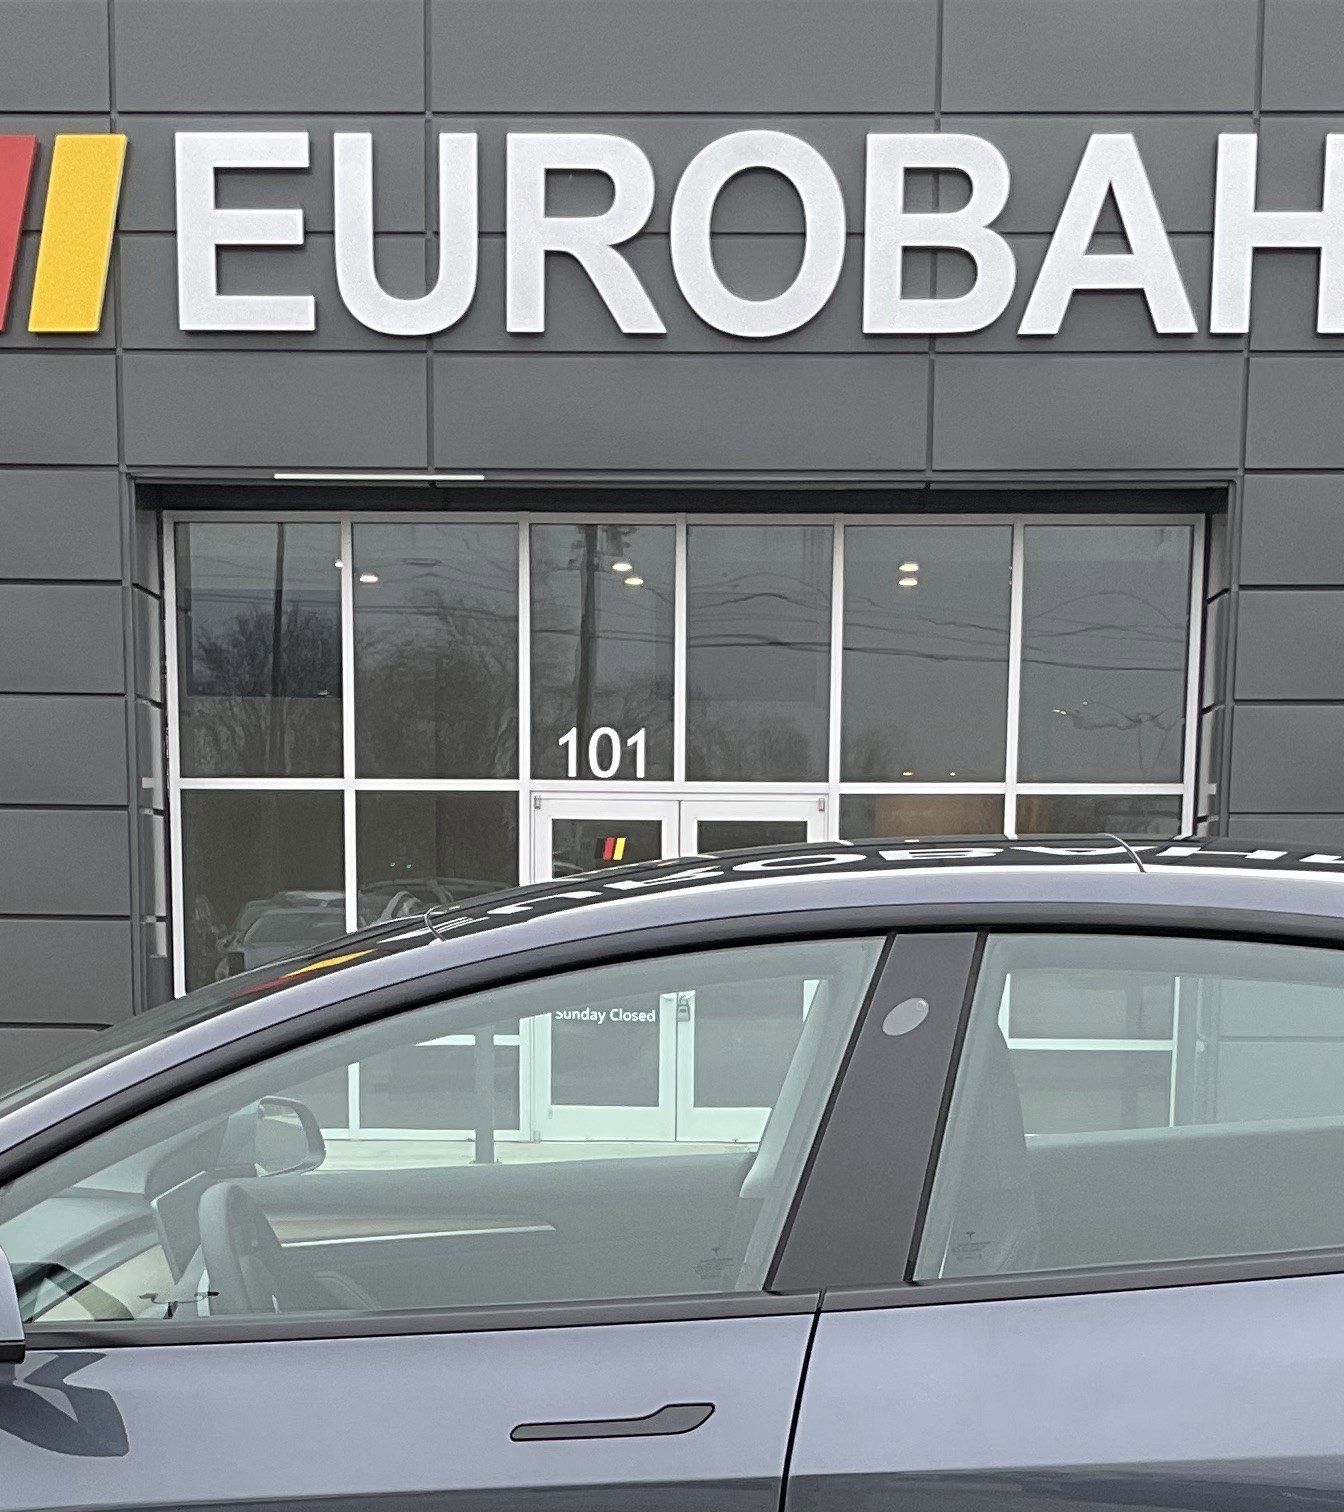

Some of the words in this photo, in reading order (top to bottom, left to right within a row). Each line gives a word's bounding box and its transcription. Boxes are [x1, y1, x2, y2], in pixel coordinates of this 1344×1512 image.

[558, 726, 645, 779] 101
[555, 1007, 607, 1025] Sunday
[609, 1007, 656, 1023] Closed
